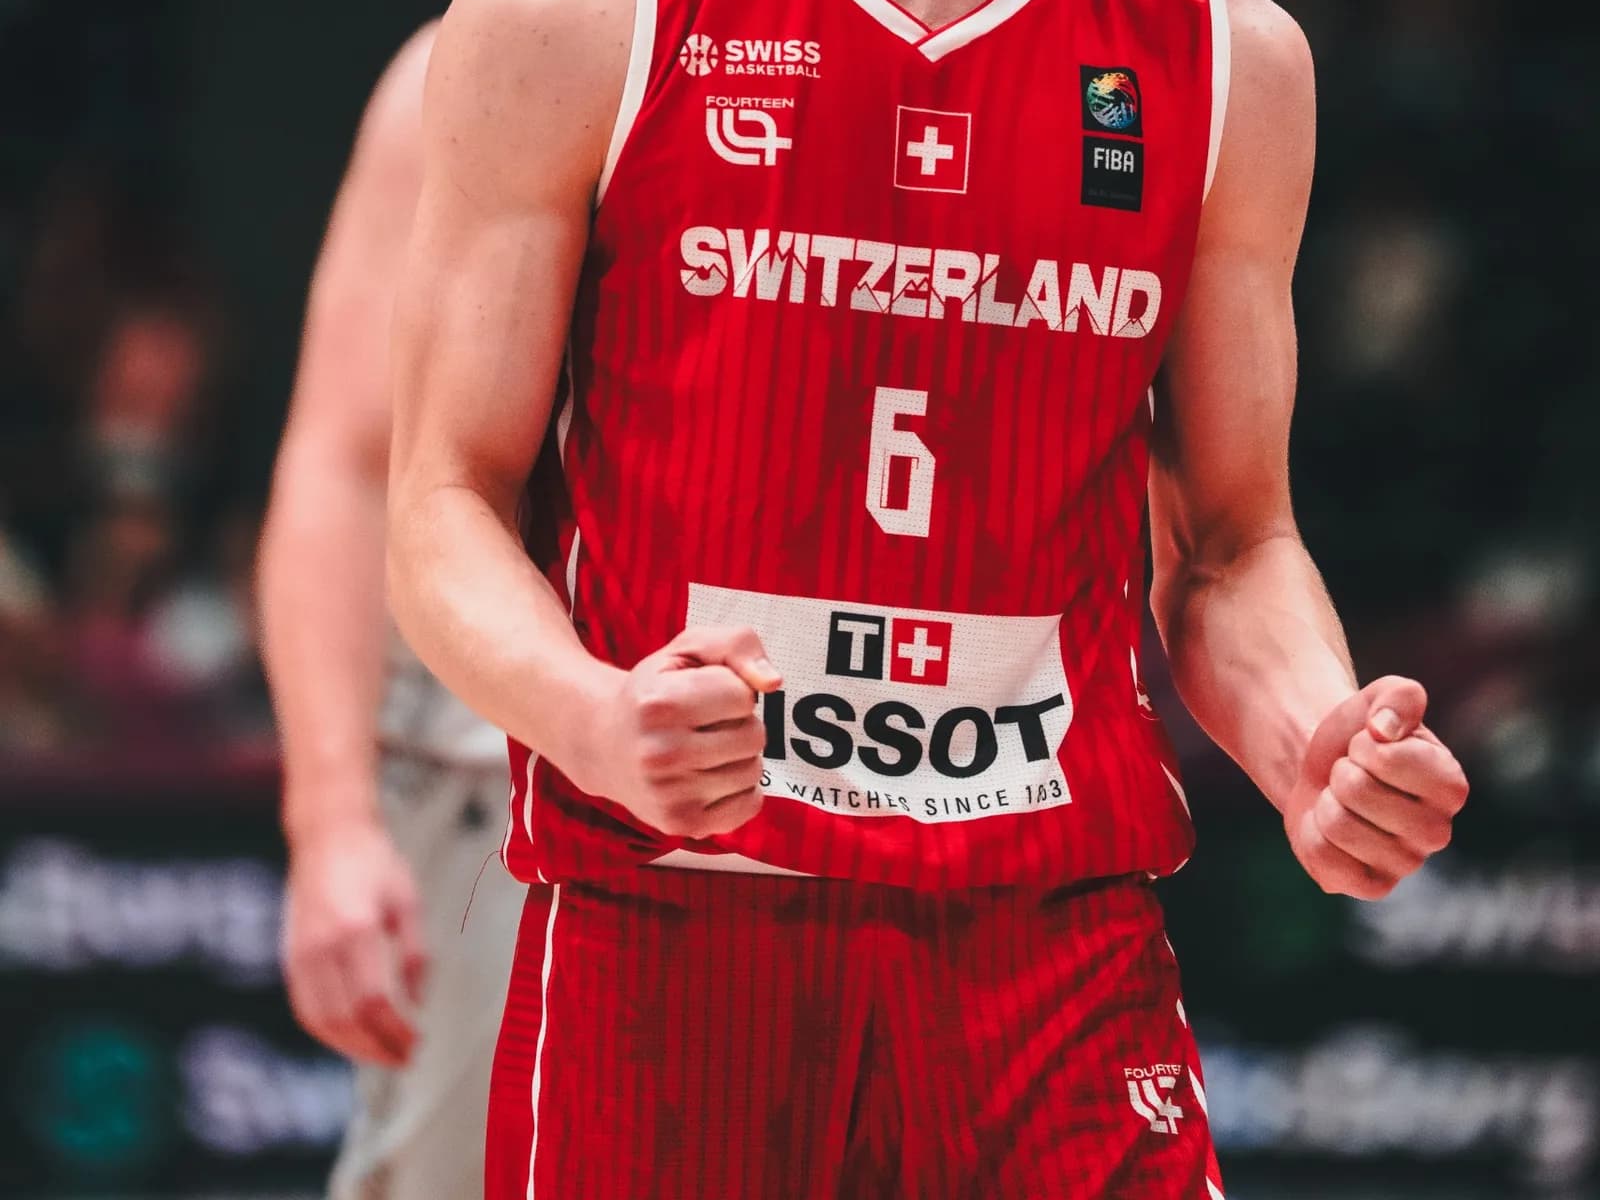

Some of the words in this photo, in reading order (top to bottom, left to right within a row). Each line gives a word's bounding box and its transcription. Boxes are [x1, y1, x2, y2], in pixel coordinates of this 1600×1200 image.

[725, 39, 822, 64] SWISS
[725, 64, 822, 79] BASKETBALL
[705, 95, 795, 109] FOURTEEN
[1093, 146, 1135, 174] FIBA
[679, 225, 1163, 339] SWITZERLAND
[865, 385, 936, 538] 6
[754, 689, 1066, 779] ISSOT
[786, 781, 911, 812] WATCHES
[924, 789, 1010, 816] SINCE
